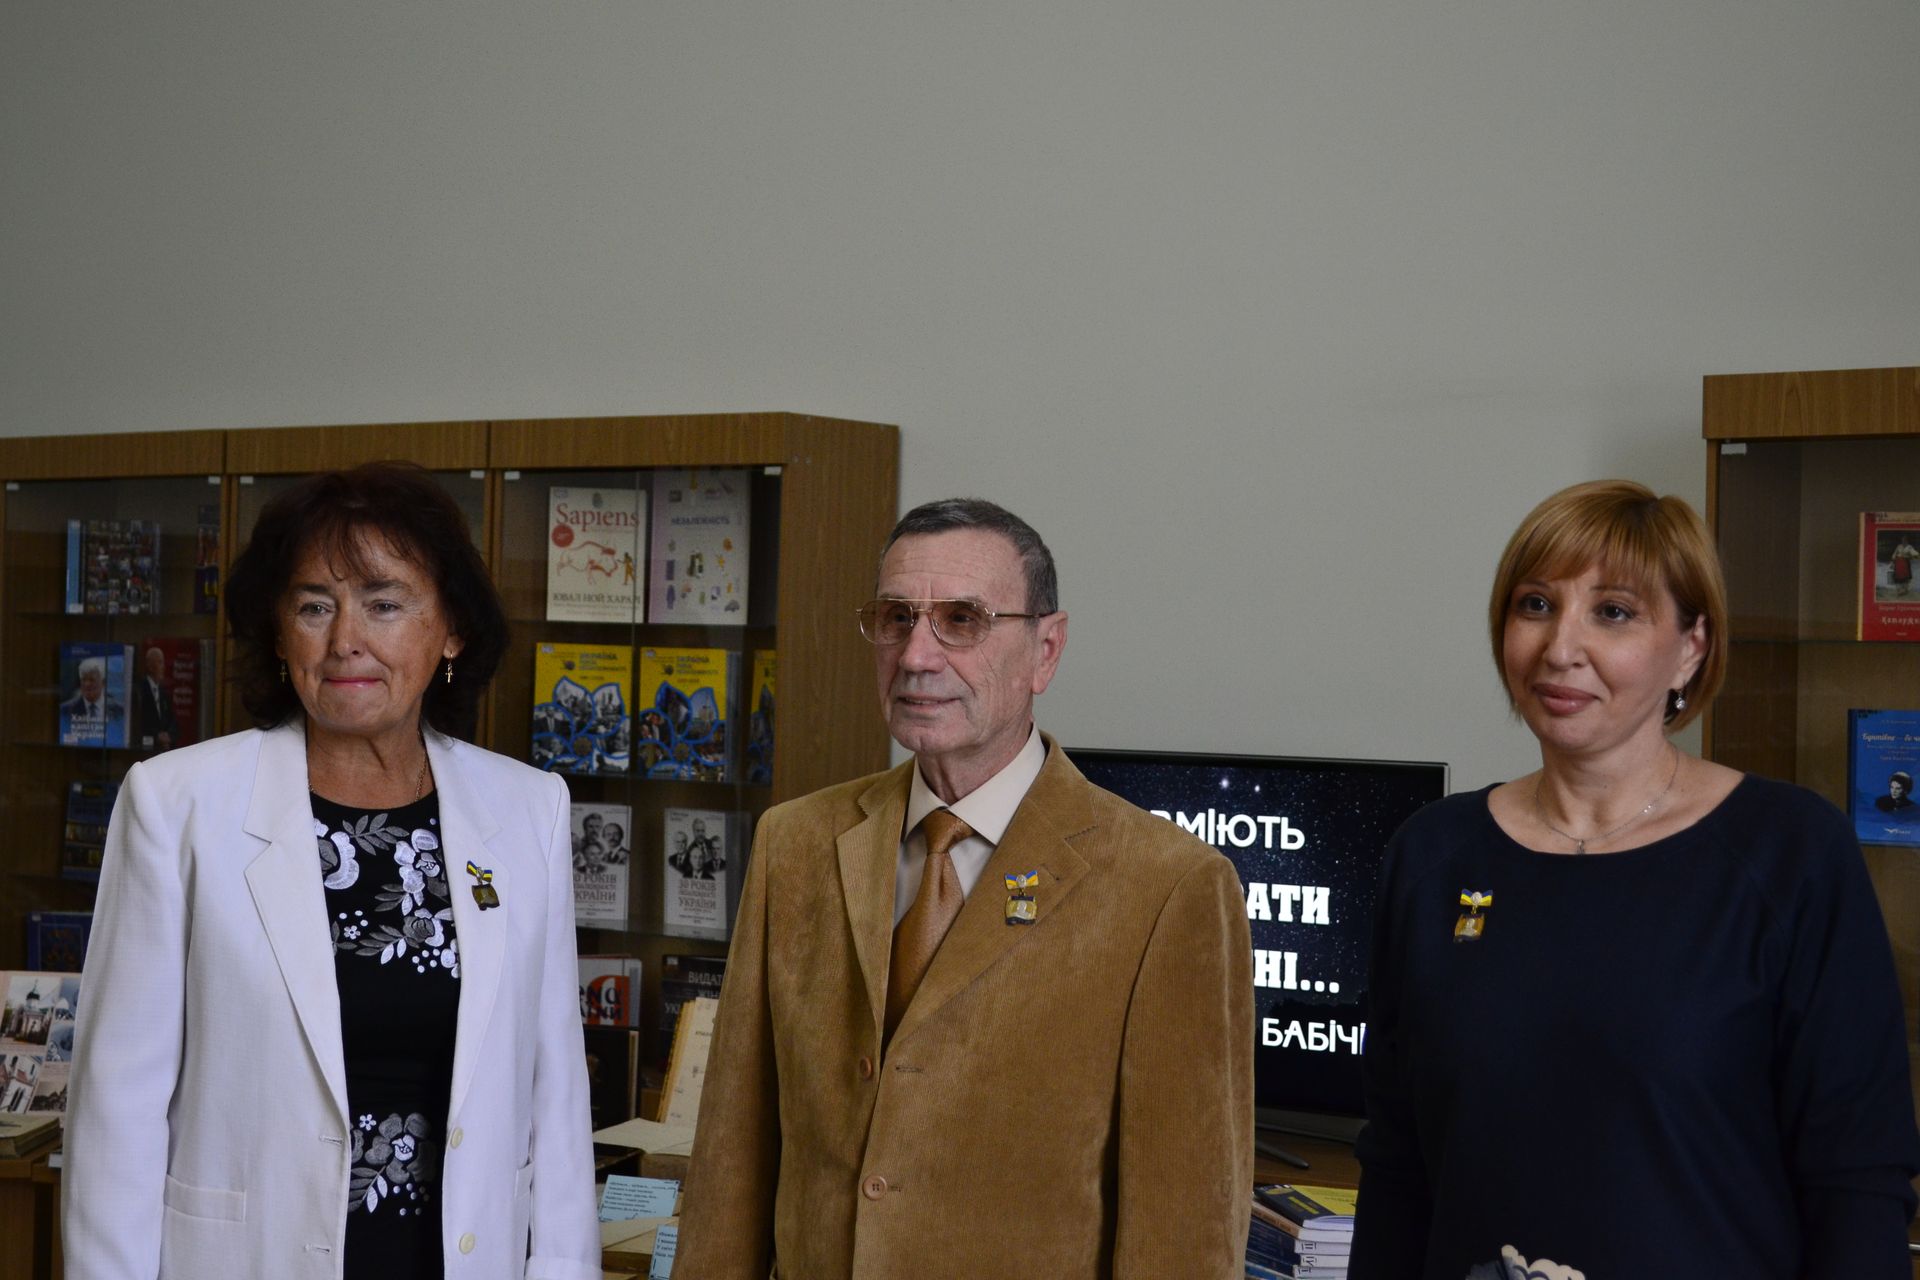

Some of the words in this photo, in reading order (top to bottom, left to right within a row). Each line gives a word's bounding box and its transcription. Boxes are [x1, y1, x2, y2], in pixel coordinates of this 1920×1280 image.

[556, 503, 640, 532] Sapiens
[1150, 808, 1305, 850] МІЮТЬ
[574, 889, 616, 901] КРАЇНИ
[1241, 882, 1330, 925] АТИ
[688, 970, 722, 986] ВИДАТ
[1251, 949, 1339, 994] НІ...
